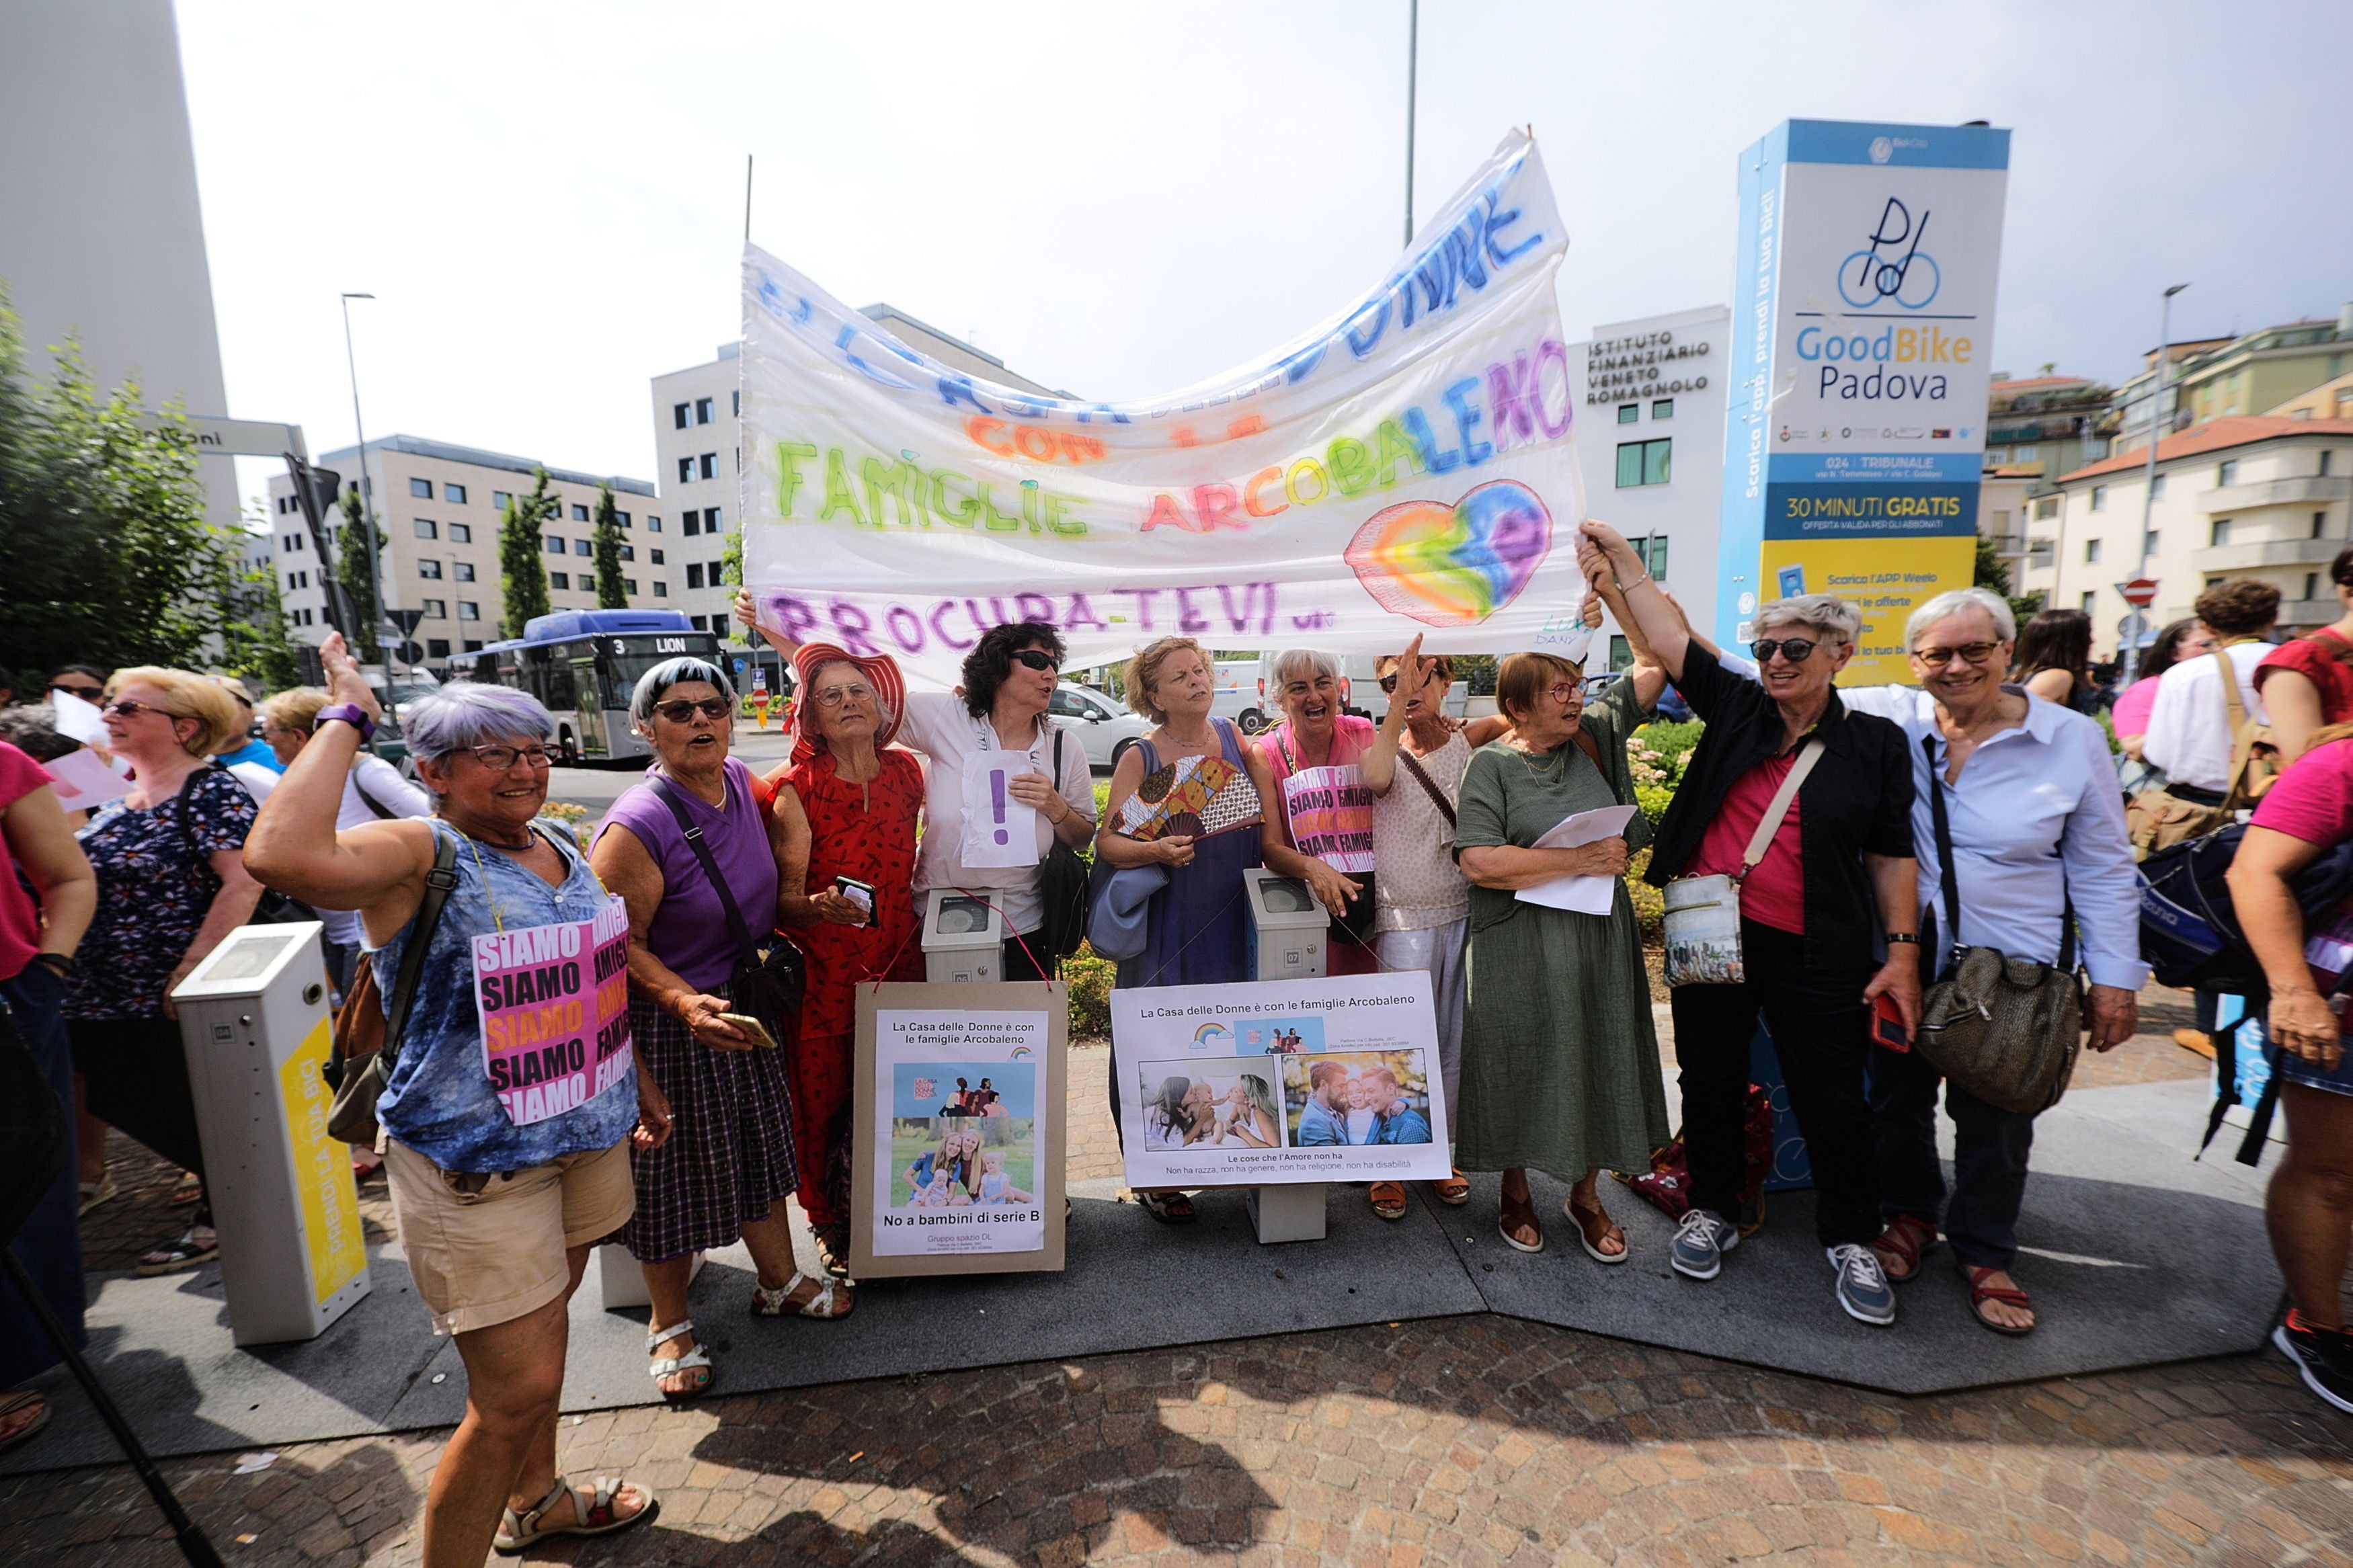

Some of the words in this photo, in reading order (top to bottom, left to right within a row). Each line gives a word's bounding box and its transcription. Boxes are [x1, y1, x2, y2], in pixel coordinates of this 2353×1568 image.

[1758, 237, 1773, 272] tua
[1756, 276, 1771, 294] la
[1588, 331, 1671, 357] ISTITUTO
[1754, 299, 1771, 363] prendi
[1797, 325, 1972, 364] GoodBike
[1588, 341, 1710, 372] FINANZIARIO
[1587, 376, 1708, 405] ROMAGNOLO
[1588, 367, 1659, 388] VENETO
[1819, 364, 1947, 401] Padova
[967, 415, 1105, 464] CON
[1140, 340, 1574, 533] ARCOBALENO
[1745, 428, 1763, 499] Scarica
[1860, 457, 1934, 469] TRIBUNALE
[1787, 497, 1810, 518] 30
[1815, 497, 1882, 517] MINUTI
[1886, 497, 1960, 515] GRATIS
[1827, 574, 1867, 585] Scarica
[612, 639, 625, 655] 3
[655, 637, 686, 653] LION
[1533, 634, 1577, 645] DANY
[1285, 767, 1330, 797] SIAMO
[1289, 788, 1334, 816] SIAMO
[477, 924, 582, 973] SIAMO
[1287, 954, 1298, 962] 07
[480, 962, 581, 1012] SIAMO
[1140, 1008, 1154, 1019] La
[1156, 1007, 1184, 1018] Casa
[1187, 1005, 1213, 1016] delle
[1215, 1003, 1251, 1015] Donne
[1254, 1002, 1261, 1013] è
[1264, 1001, 1284, 1012] con
[1288, 1000, 1298, 1011] le
[1301, 998, 1346, 1012] famiglie
[1348, 994, 1415, 1007] Arcobaleno
[485, 999, 584, 1053] SIAMO
[893, 1022, 906, 1032] La
[909, 1022, 935, 1032] Casa
[939, 1022, 964, 1032] delle
[968, 1022, 1002, 1032] Donne
[1006, 1023, 1012, 1032] è
[906, 1034, 915, 1044] le
[918, 1034, 960, 1046] famiglie
[963, 1034, 1025, 1044] Arcobaleno
[301, 1056, 321, 1101] BICI
[489, 1038, 586, 1093] SIAMO
[309, 1100, 327, 1147] TUA
[315, 1145, 334, 1177] LA
[1166, 1167, 1183, 1175] Non
[1195, 1167, 1219, 1175] razza,
[1248, 1165, 1278, 1175] genere,
[1309, 1162, 1345, 1173] religione,
[1346, 1162, 1362, 1170] non
[1363, 1161, 1374, 1169] ha
[1375, 1159, 1412, 1169] disabilità
[1228, 1155, 1239, 1163] Le
[1262, 1154, 1277, 1162] che
[1279, 1153, 1312, 1161] l'Amore
[320, 1175, 346, 1255] PRENDI
[884, 1214, 902, 1227] No
[907, 1217, 914, 1226] a
[918, 1212, 973, 1225] bambini
[977, 1212, 990, 1223] di
[994, 1211, 1027, 1223] serie
[1031, 1210, 1040, 1222] B
[927, 1235, 955, 1243] Gruppo
[956, 1234, 980, 1242] spazio
[982, 1233, 992, 1241] DL
